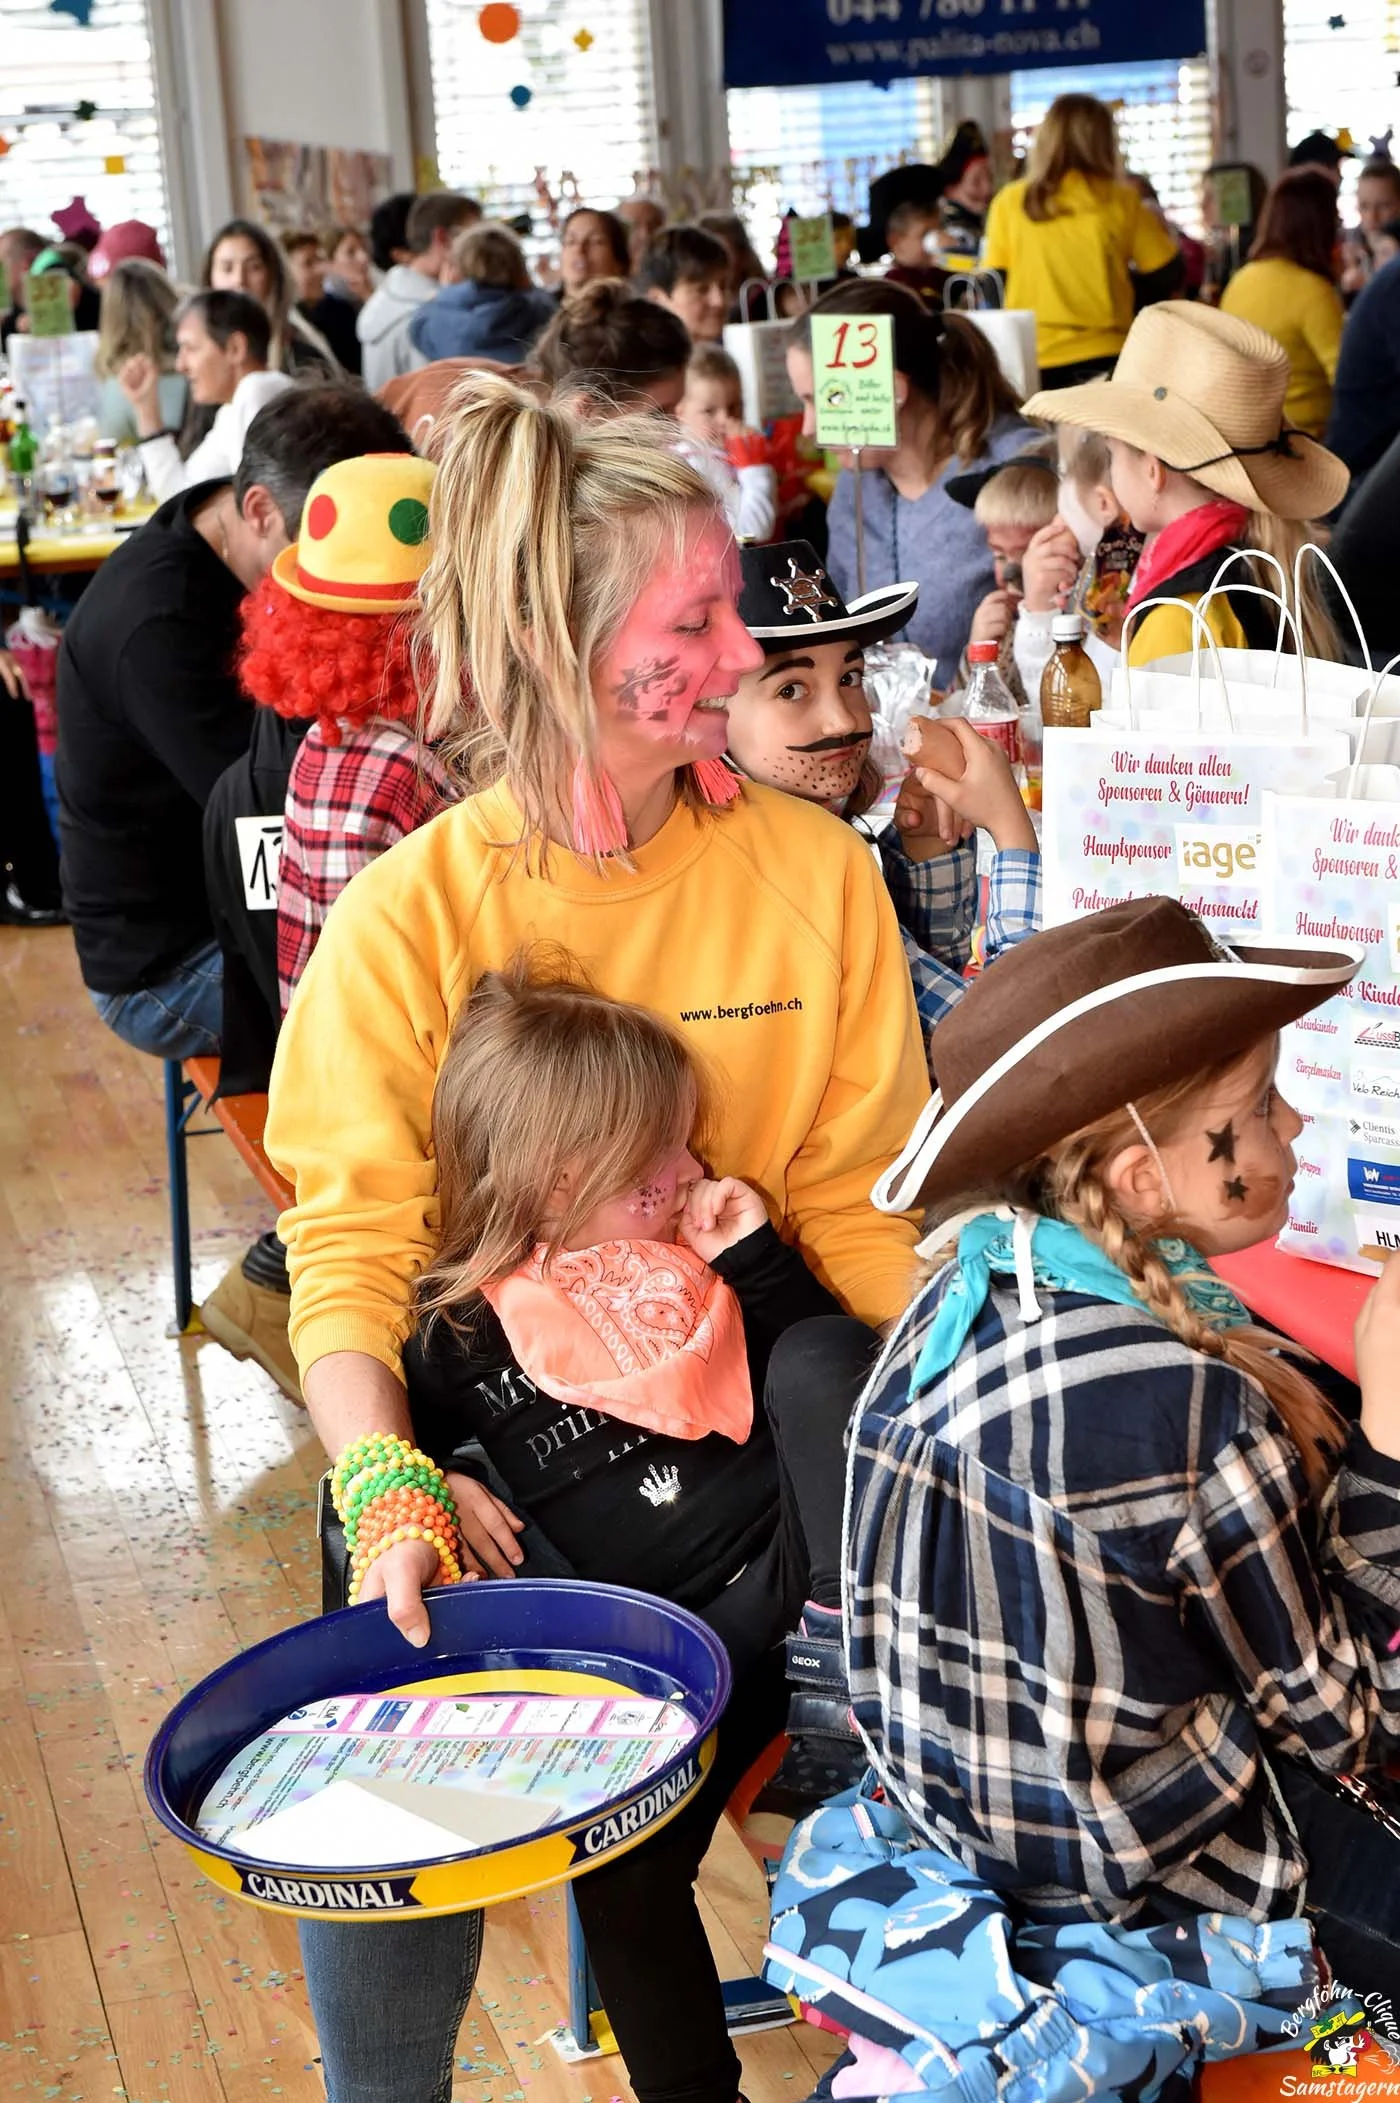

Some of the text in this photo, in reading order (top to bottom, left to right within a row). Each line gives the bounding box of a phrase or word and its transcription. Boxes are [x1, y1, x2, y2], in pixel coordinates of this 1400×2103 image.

[826, 322, 878, 368] 13
[1111, 751, 1231, 777] Wir danken allen
[1097, 778, 1250, 812] Sponsoren & Gönnern!
[1329, 818, 1359, 843] Wir
[1082, 834, 1172, 866] Hauptsponsor
[1312, 847, 1398, 881] Sponsoren &
[250, 836, 284, 901] 1
[1296, 911, 1385, 944] Hauptsponsor
[680, 997, 803, 1022] www.bergfoehn.ch
[1295, 1058, 1342, 1081] Einzelmasken
[1353, 1081, 1369, 1094] Velo
[1363, 1120, 1396, 1135] Clientis
[1288, 1216, 1320, 1235] Familie
[474, 1366, 539, 1418] My
[791, 1654, 821, 1668] GEOX
[584, 1758, 697, 1854] CARDINAL
[247, 1873, 404, 1909] CARDINAL
